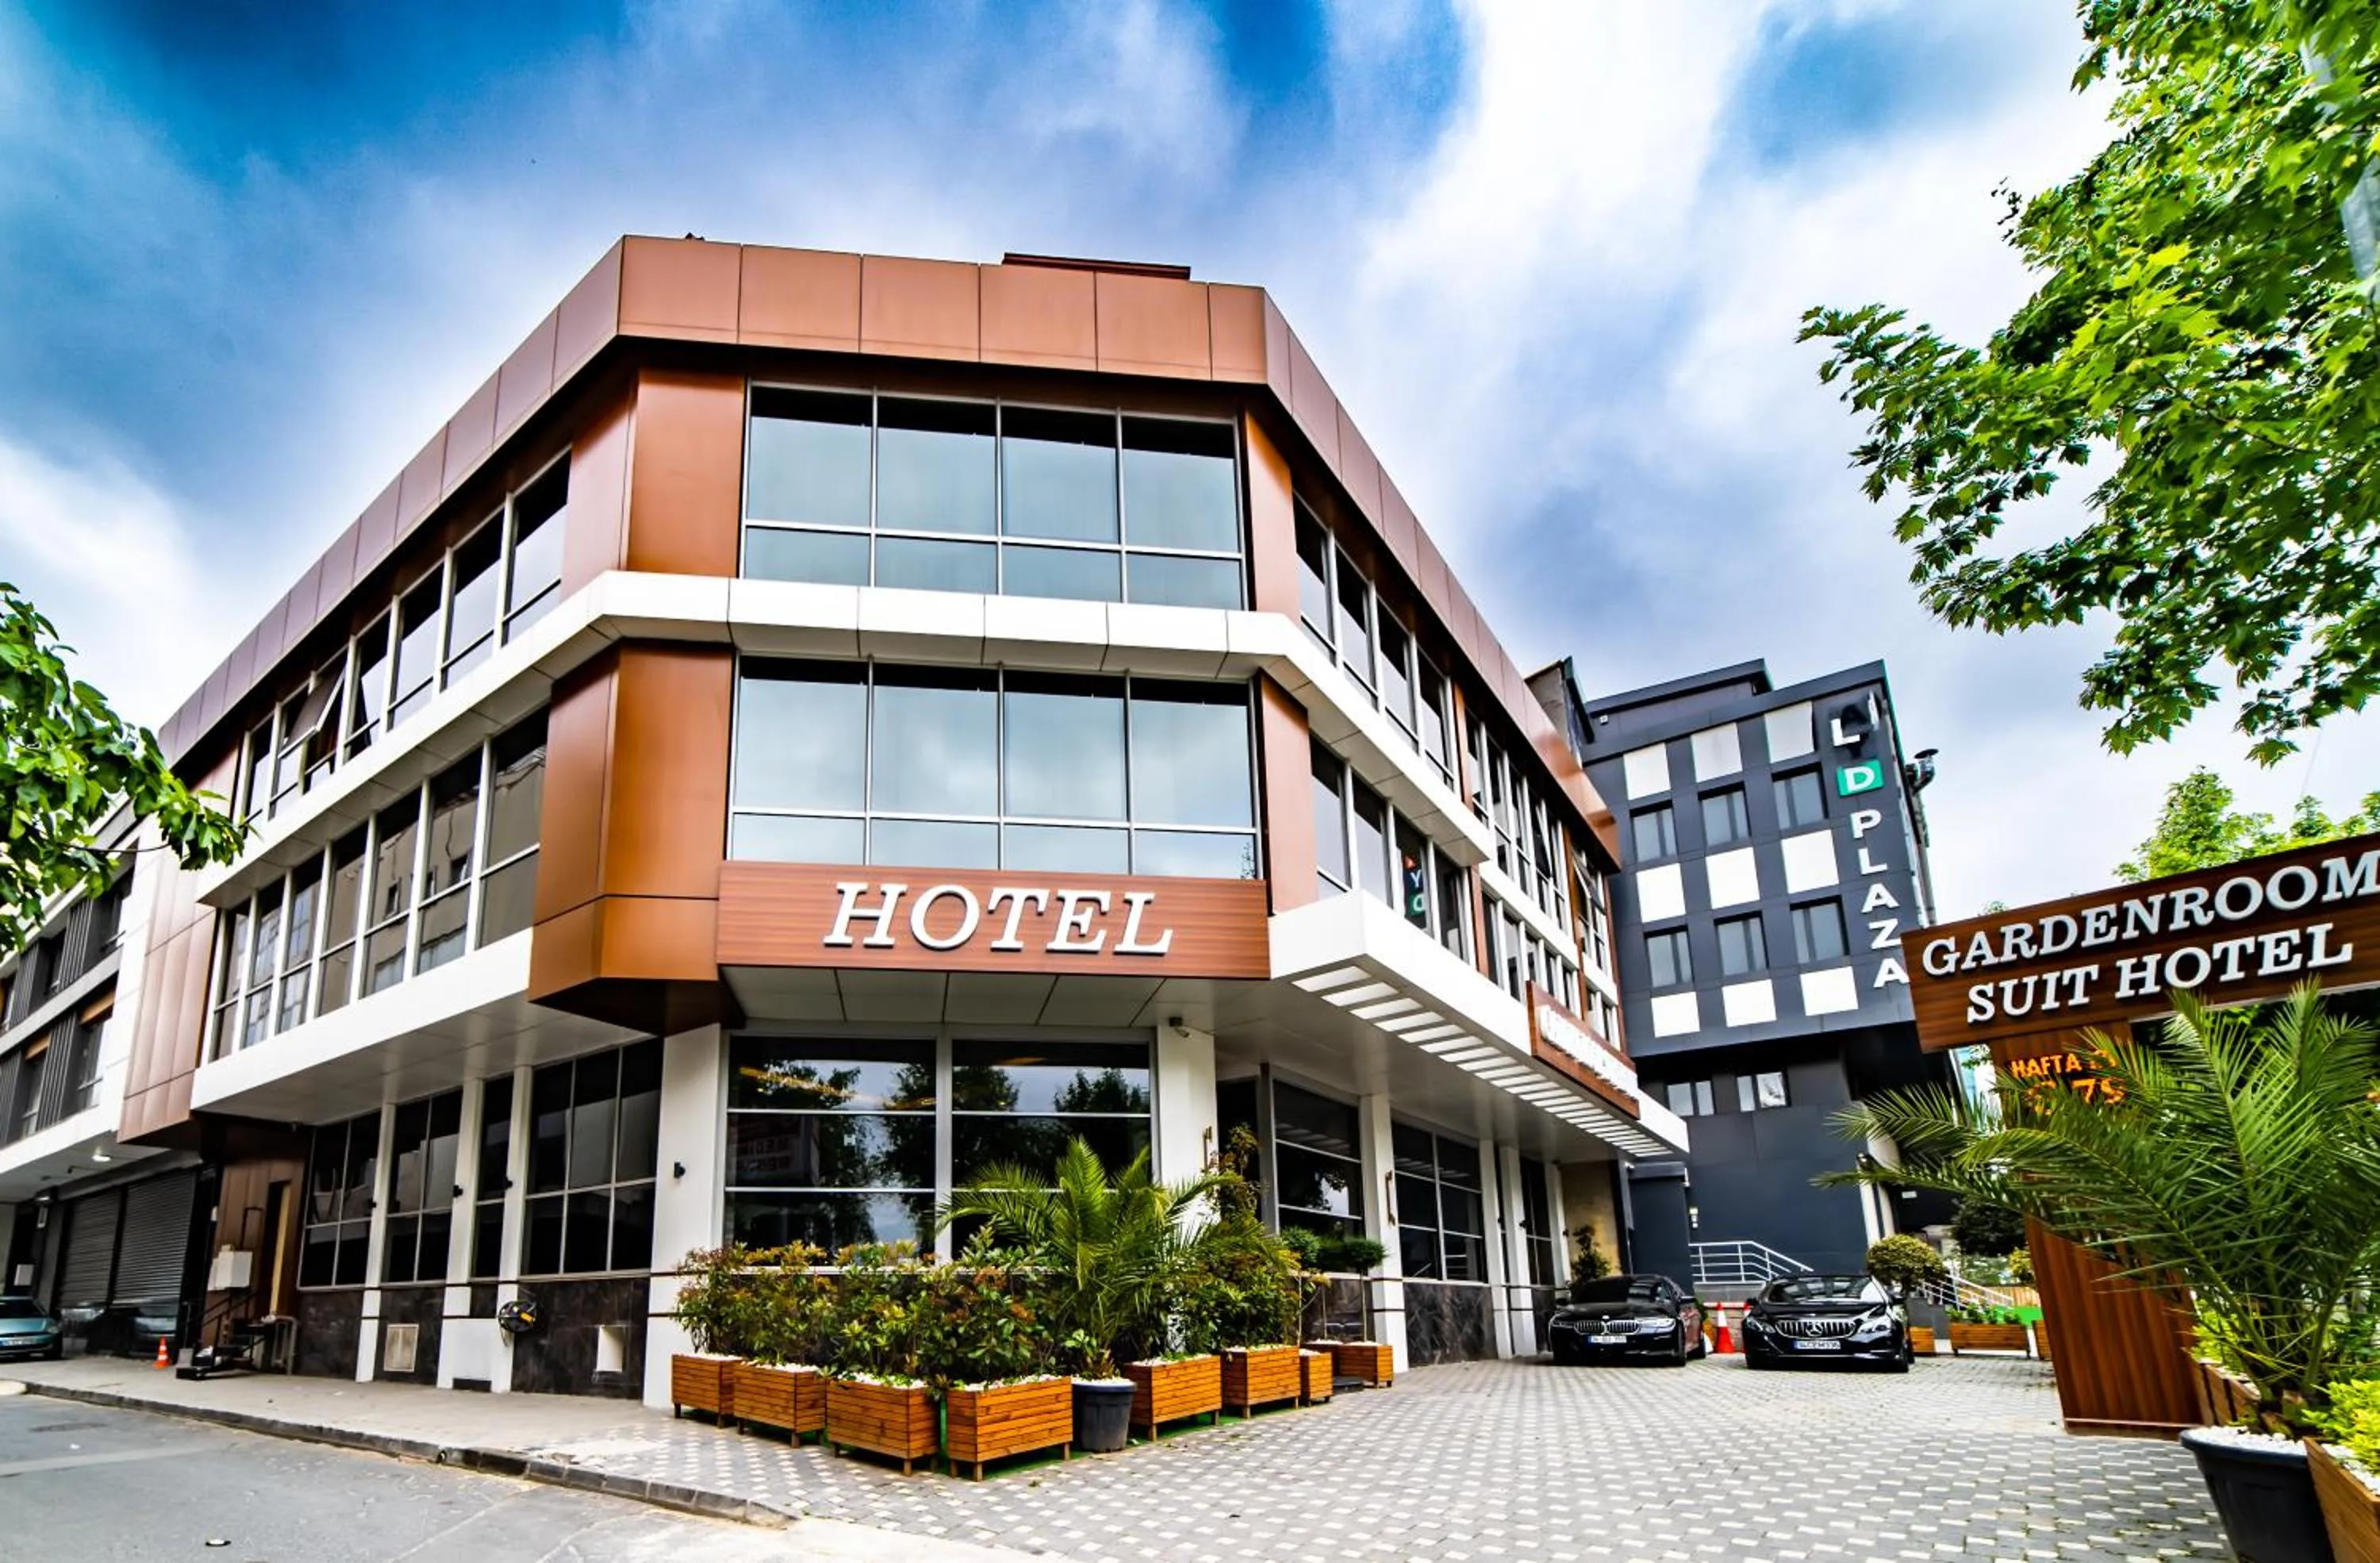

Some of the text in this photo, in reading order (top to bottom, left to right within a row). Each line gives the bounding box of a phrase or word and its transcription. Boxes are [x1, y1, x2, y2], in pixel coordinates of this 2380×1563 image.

[823, 882, 1173, 955] HOTEL
[1850, 809, 1910, 989] PLAZA
[1922, 850, 2380, 976] GARDENROOM
[1967, 922, 2353, 1023] SUIT HOTEL
[2011, 1054, 2082, 1079] HAFTA
